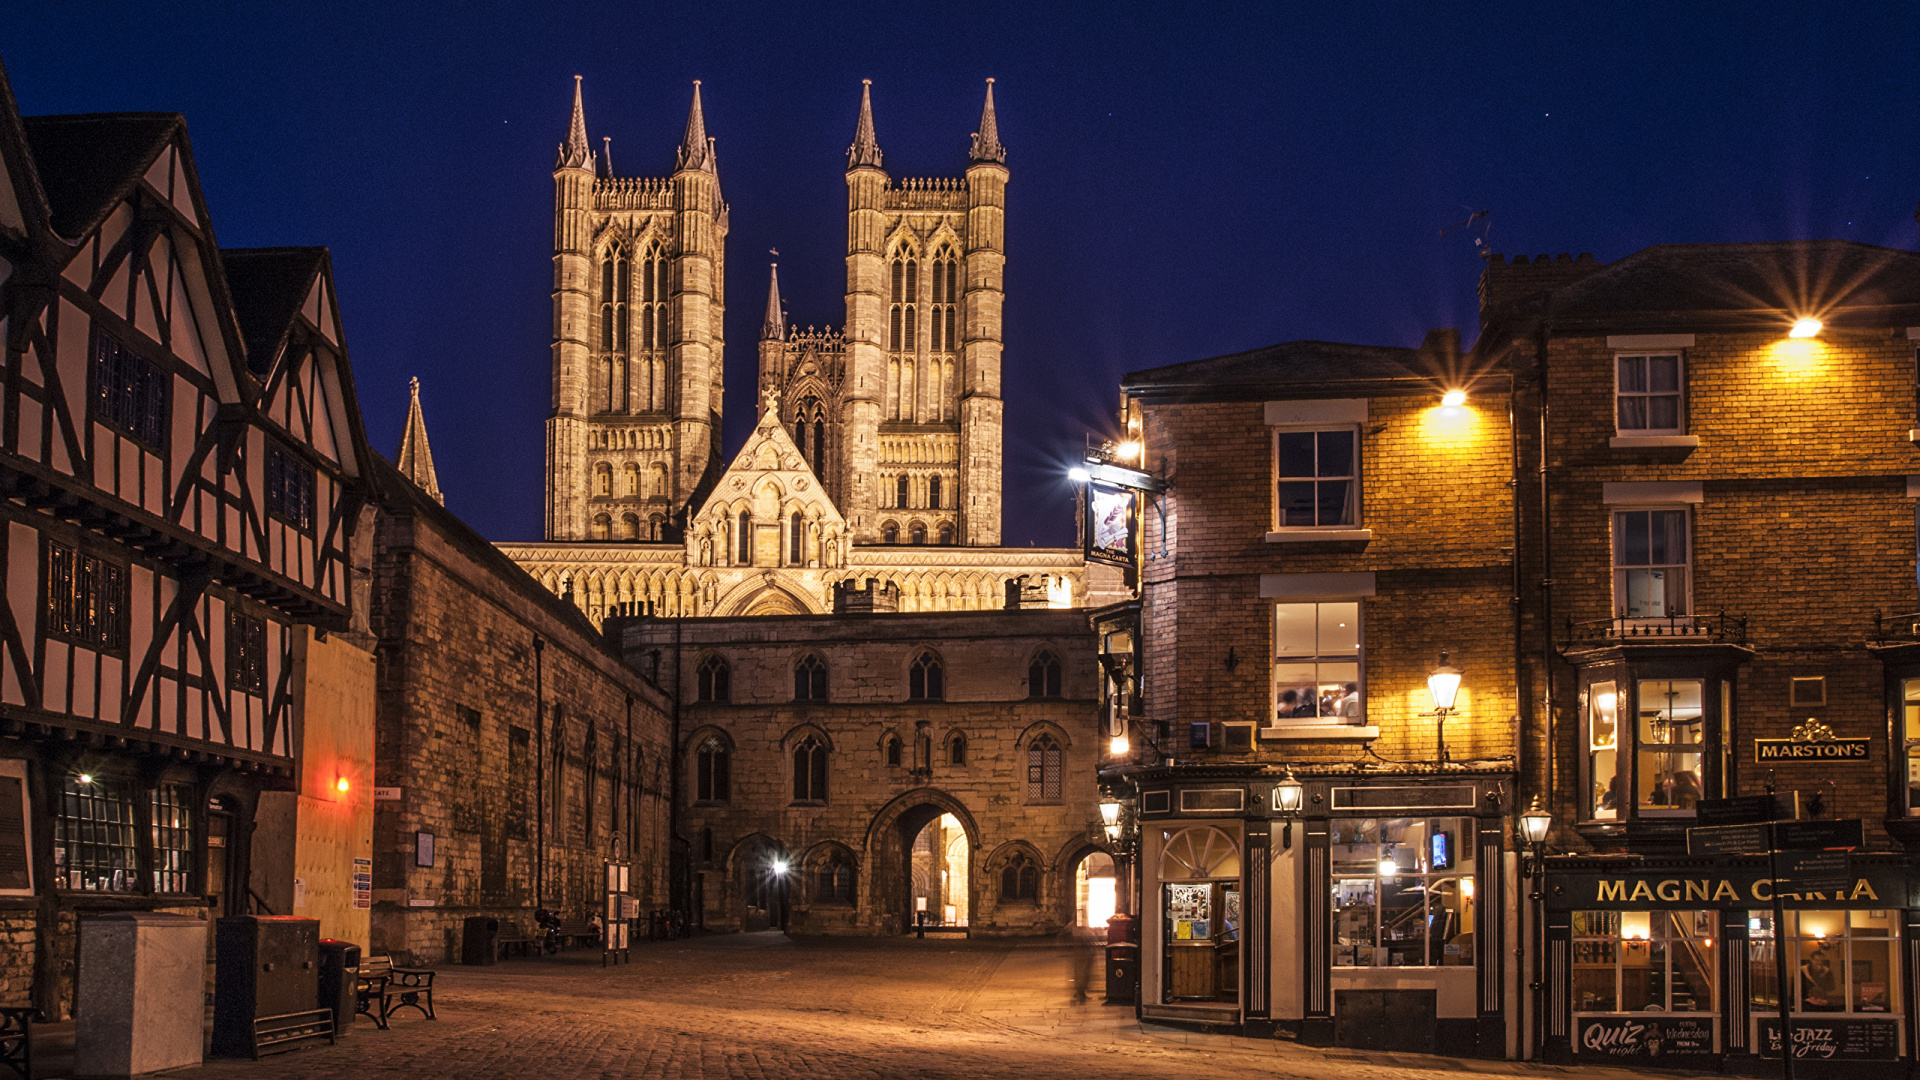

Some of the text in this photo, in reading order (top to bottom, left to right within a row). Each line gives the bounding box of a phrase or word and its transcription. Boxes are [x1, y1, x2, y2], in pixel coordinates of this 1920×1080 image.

[1090, 550, 1130, 563] MAGNA CARTA
[1761, 744, 1865, 757] MARSTON'S
[1596, 880, 1740, 901] MAGNA
[1666, 1027, 1710, 1042] Wednesday
[1768, 1027, 1794, 1040] Li
[1793, 1028, 1833, 1042] JAZZ
[1610, 1044, 1642, 1057] night
